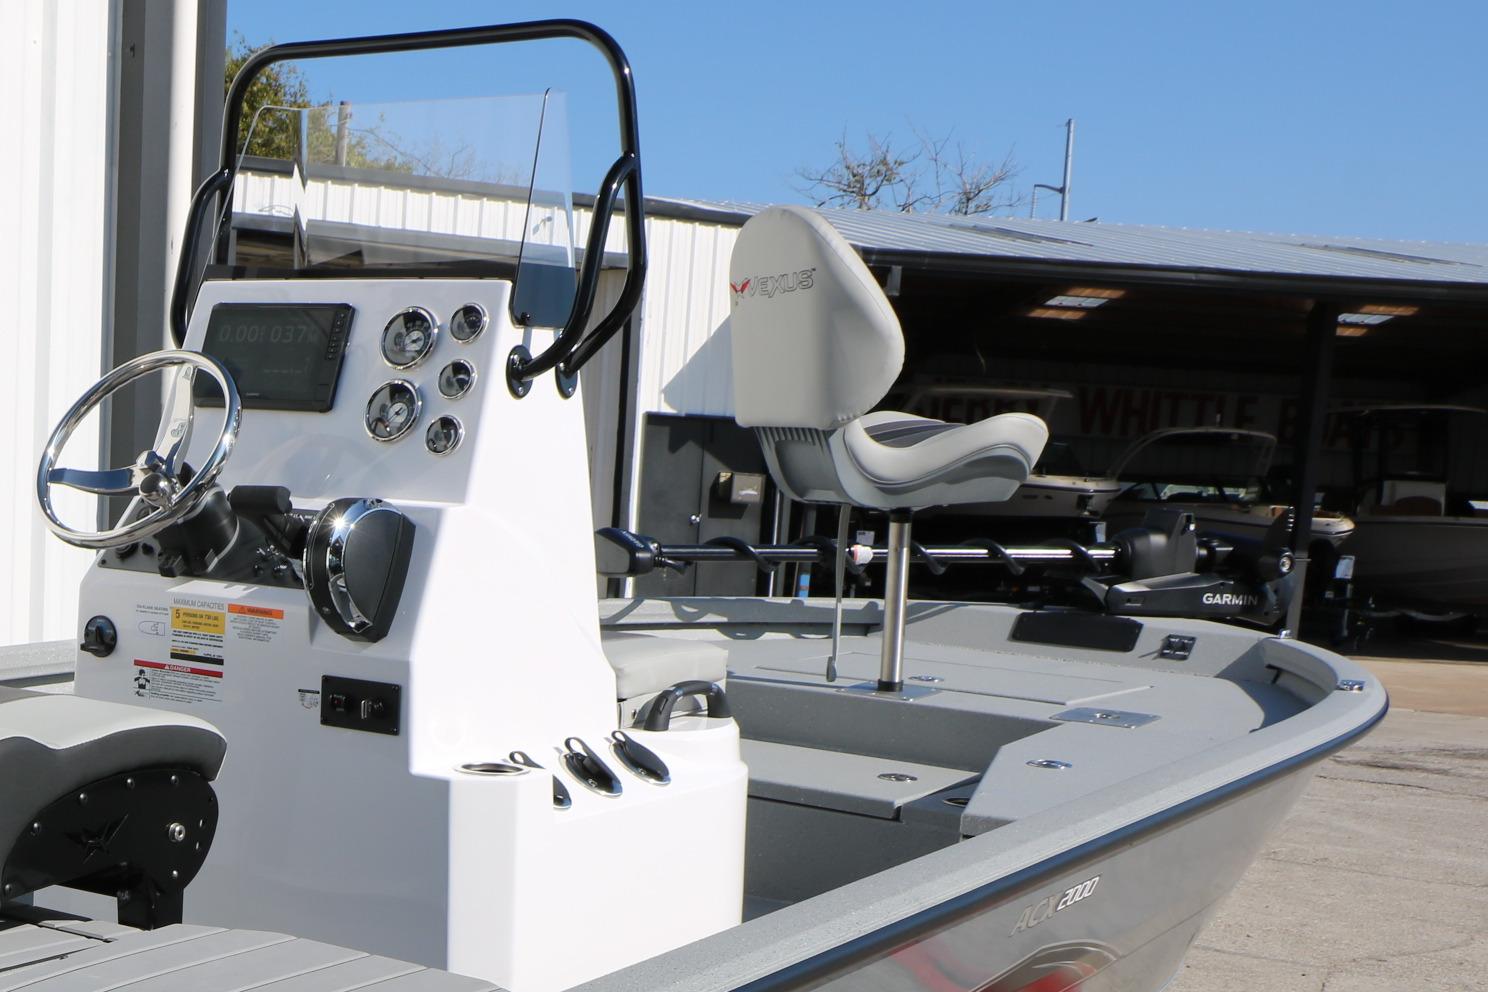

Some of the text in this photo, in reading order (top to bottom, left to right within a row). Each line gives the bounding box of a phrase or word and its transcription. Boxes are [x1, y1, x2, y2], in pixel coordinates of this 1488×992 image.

[751, 269, 814, 298] VEXUS
[1202, 592, 1259, 606] GARMIN
[196, 600, 225, 611] CAPACITIES
[170, 664, 192, 673] DANGER
